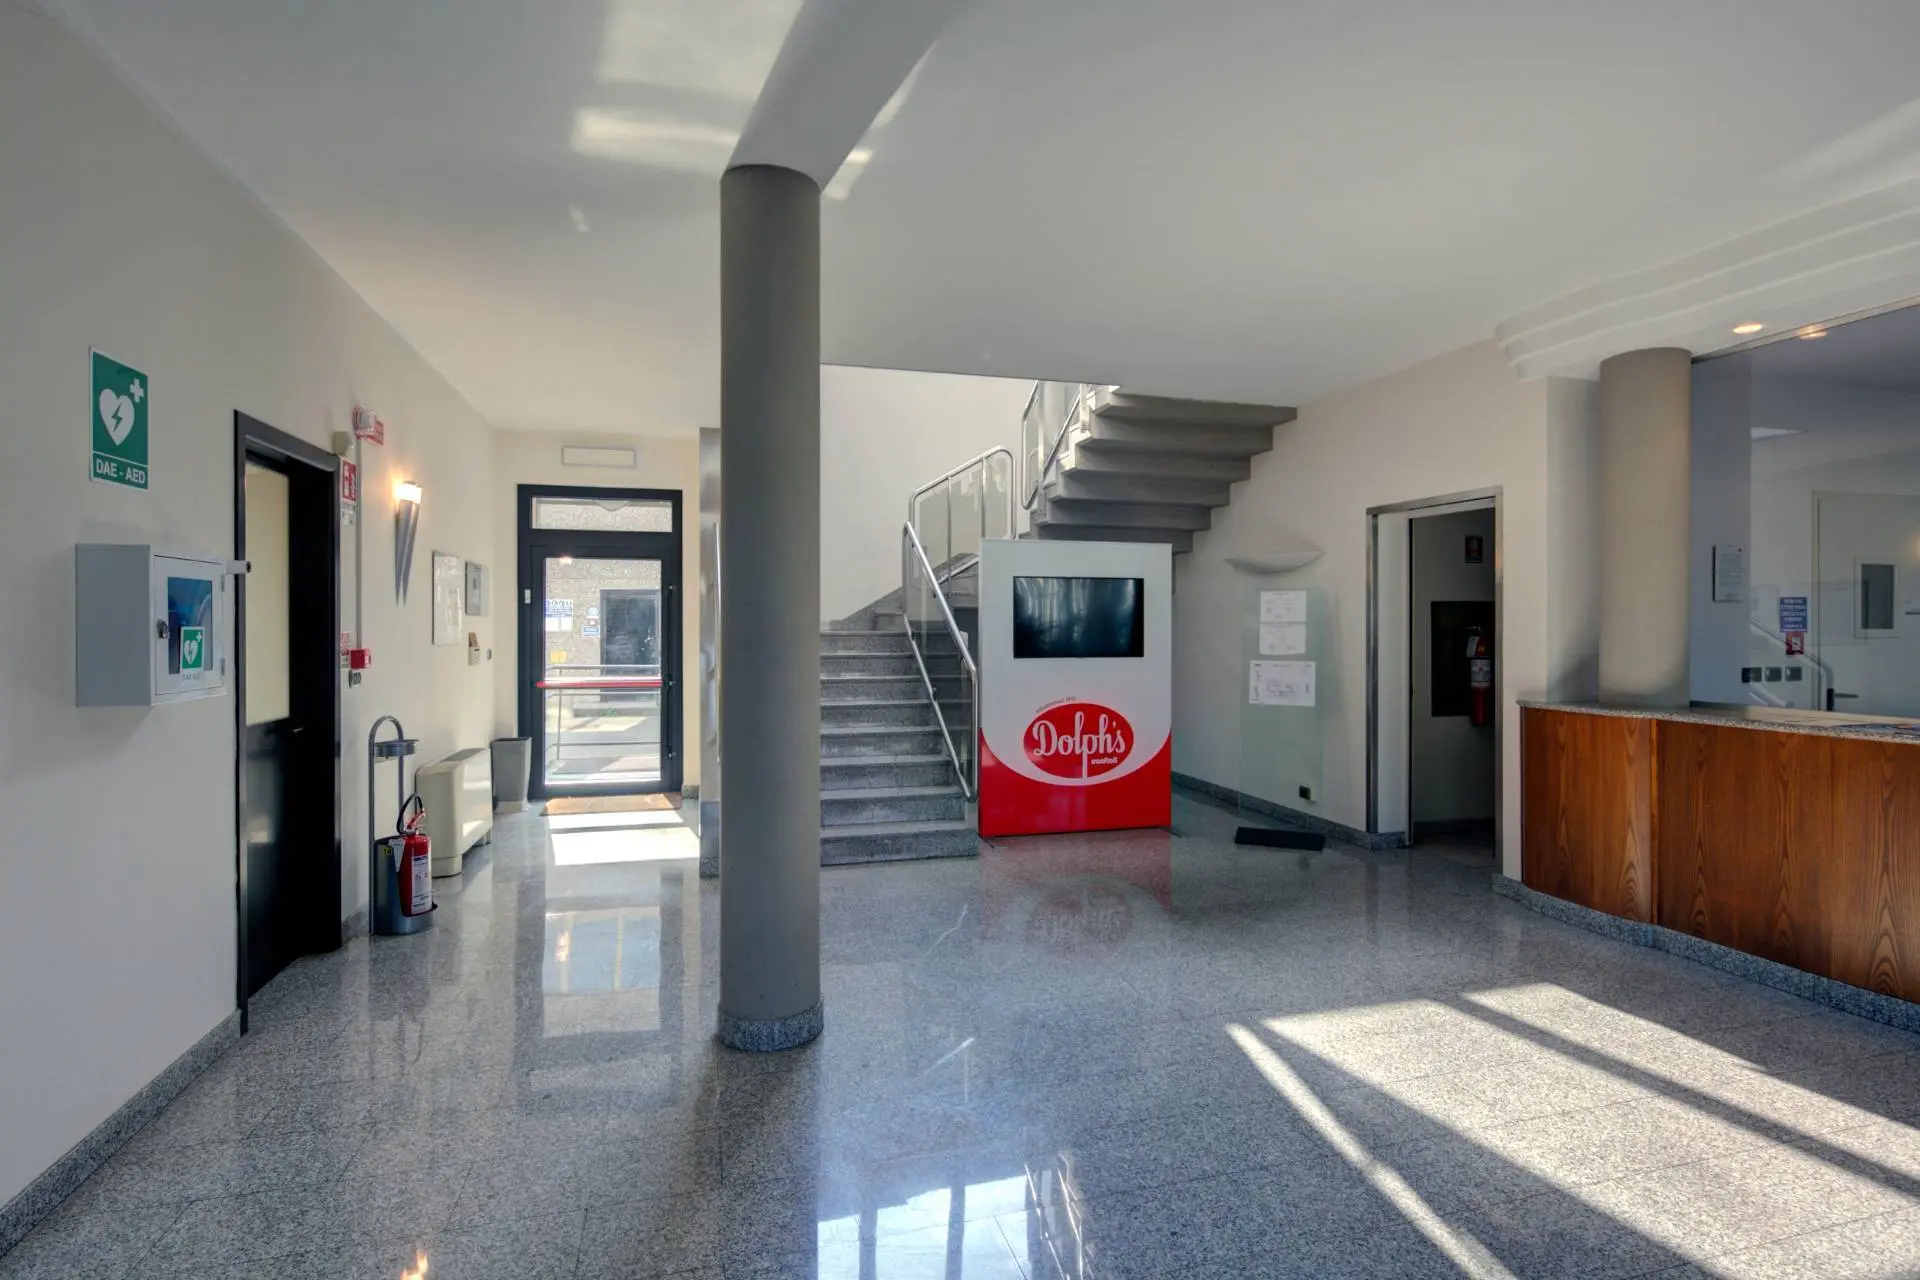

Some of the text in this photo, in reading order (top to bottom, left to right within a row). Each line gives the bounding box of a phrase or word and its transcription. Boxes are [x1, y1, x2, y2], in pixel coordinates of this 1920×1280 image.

[96, 458, 118, 477] DAE
[125, 467, 146, 485] AED
[1032, 711, 1126, 778] Dolph's
